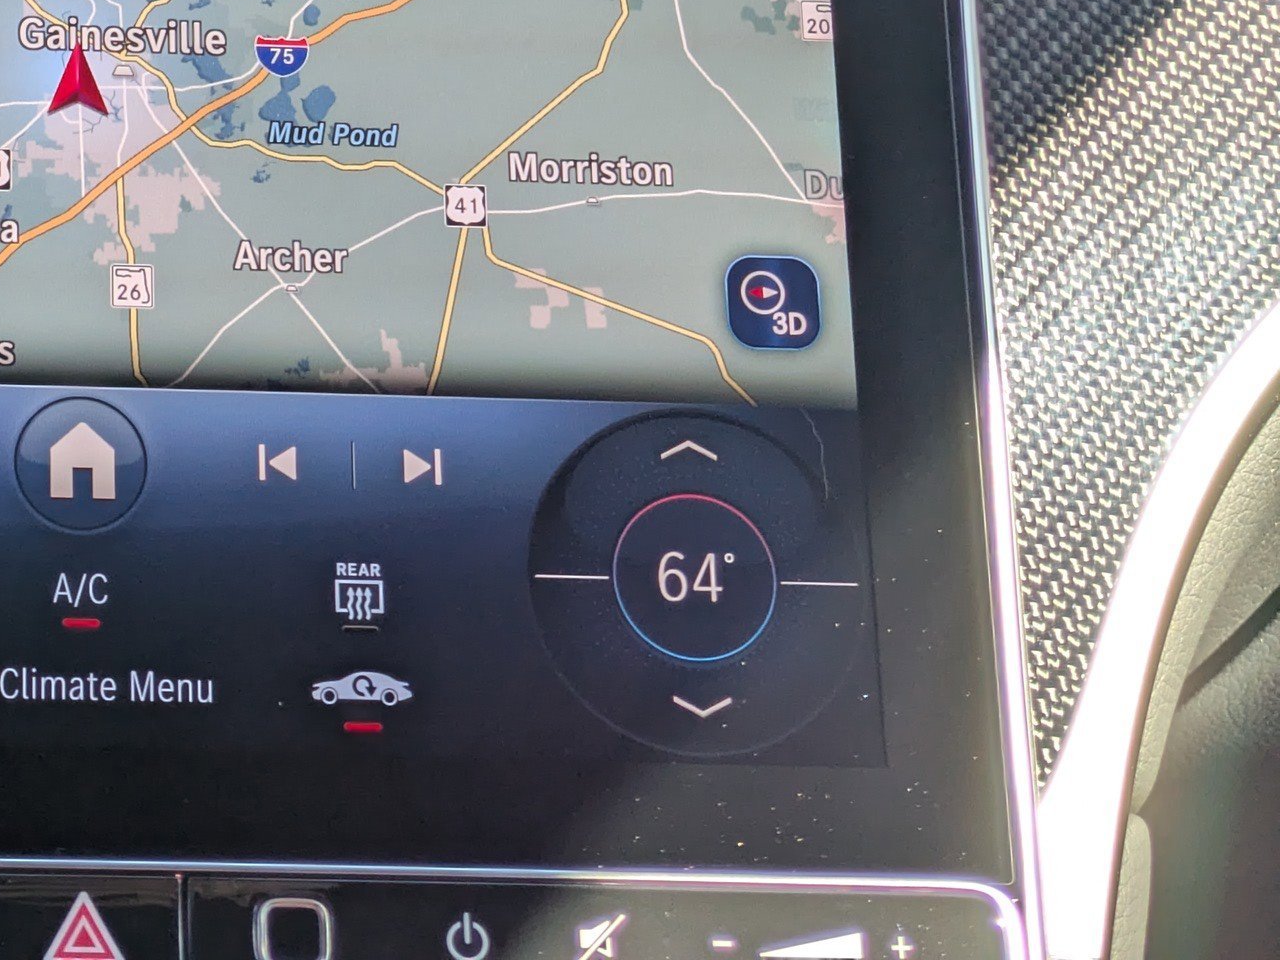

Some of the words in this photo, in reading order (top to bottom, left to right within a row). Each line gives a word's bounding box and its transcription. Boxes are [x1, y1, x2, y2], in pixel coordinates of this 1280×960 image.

[19, 16, 226, 56] Gainesville
[807, 18, 830, 34] 20
[270, 47, 294, 64] 75
[268, 121, 326, 145] Mud
[333, 123, 397, 147] Pond
[507, 151, 673, 187] Morriston
[455, 198, 478, 214] 41
[233, 240, 348, 274] Archer
[117, 283, 141, 301] 26
[772, 312, 808, 336] 3D
[336, 562, 381, 577] REAR
[53, 572, 109, 606] A/C
[0, 667, 117, 702] Climate
[130, 671, 214, 703] Menu
